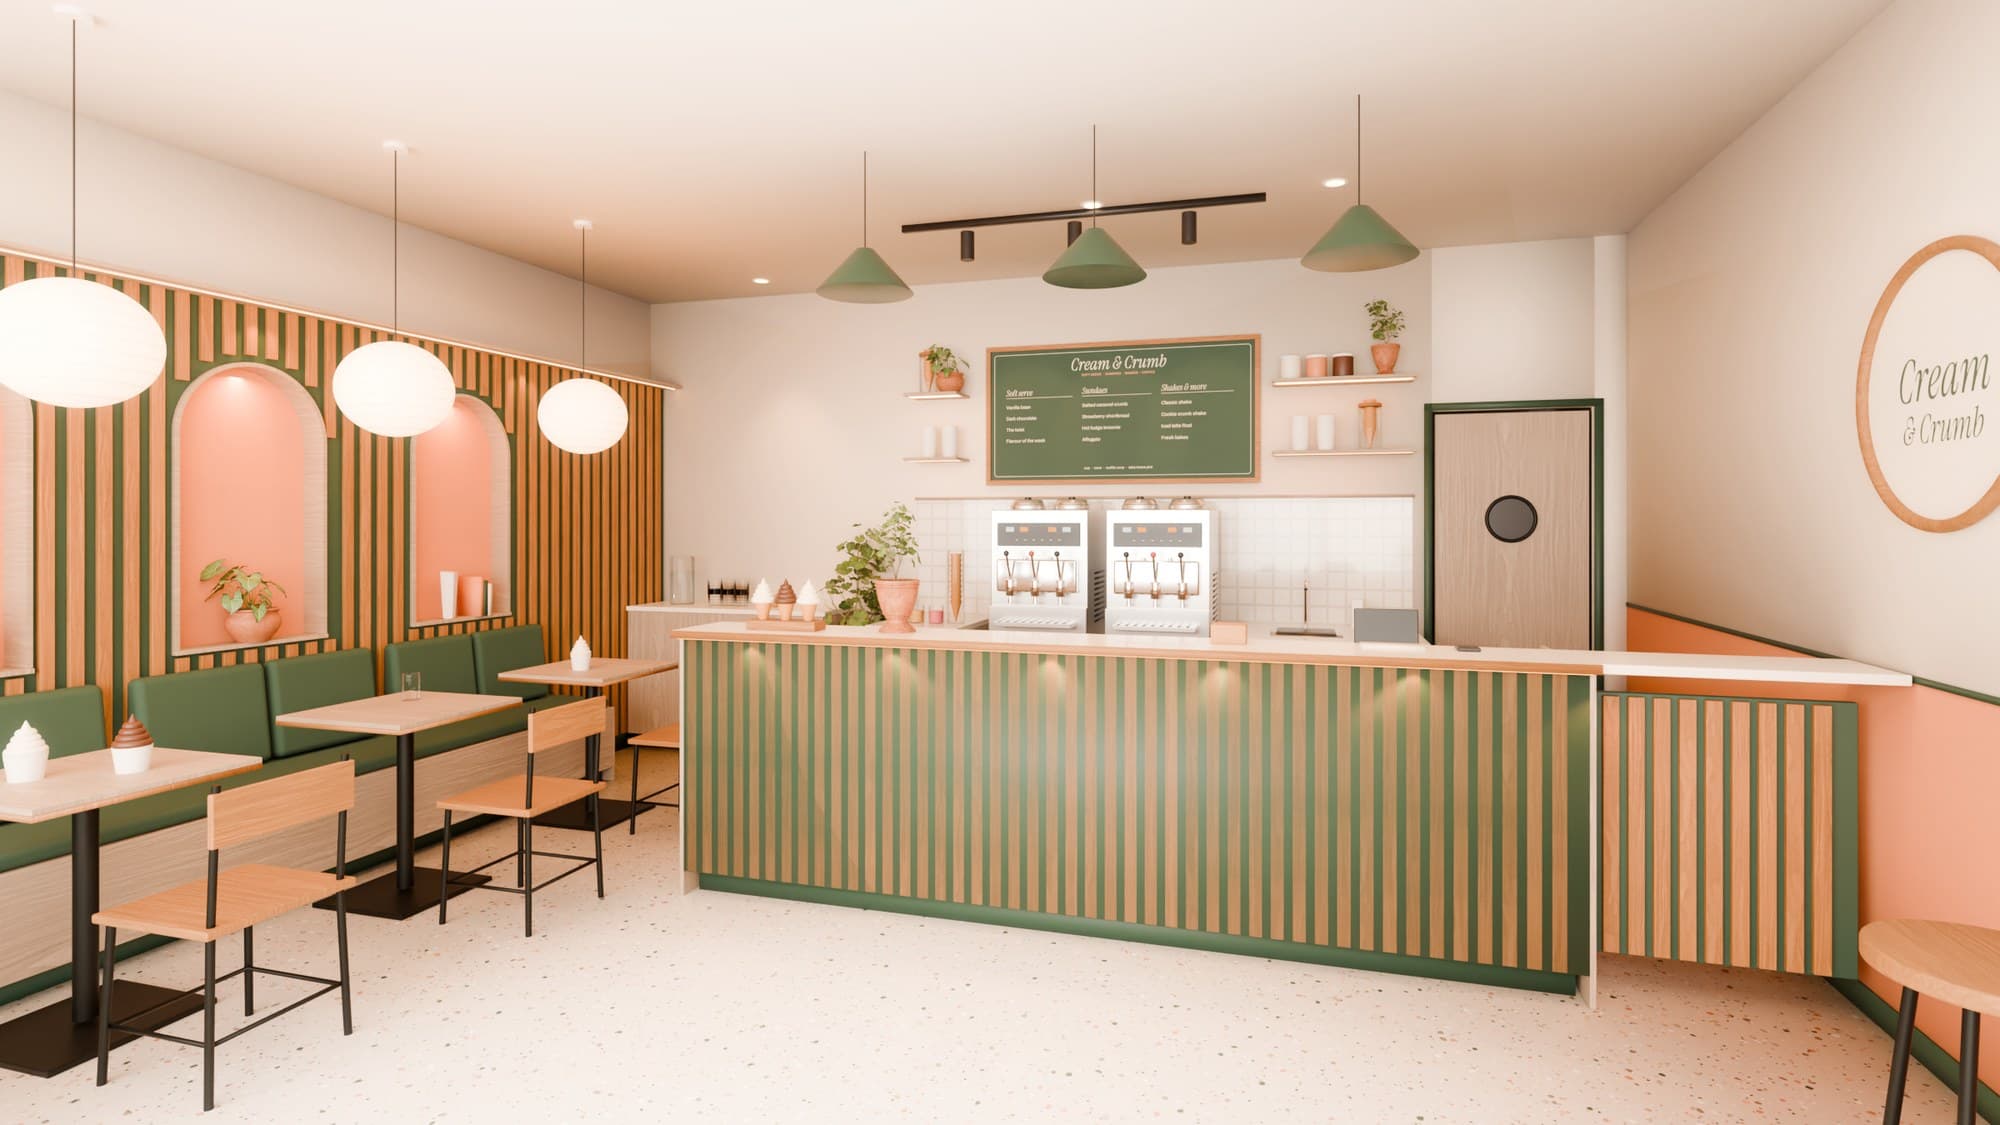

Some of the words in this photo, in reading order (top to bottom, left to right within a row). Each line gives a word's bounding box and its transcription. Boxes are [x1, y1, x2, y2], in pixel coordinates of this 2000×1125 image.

[1071, 357, 1110, 372] Cream
[1112, 355, 1122, 370] &
[1124, 353, 1167, 369] Crumb
[1161, 384, 1183, 392] Shakes
[1183, 382, 1190, 391] &
[1900, 354, 1990, 404] Cream
[1006, 389, 1018, 398] Soft
[1904, 416, 1916, 446] &
[1919, 405, 1985, 444] Crumb
